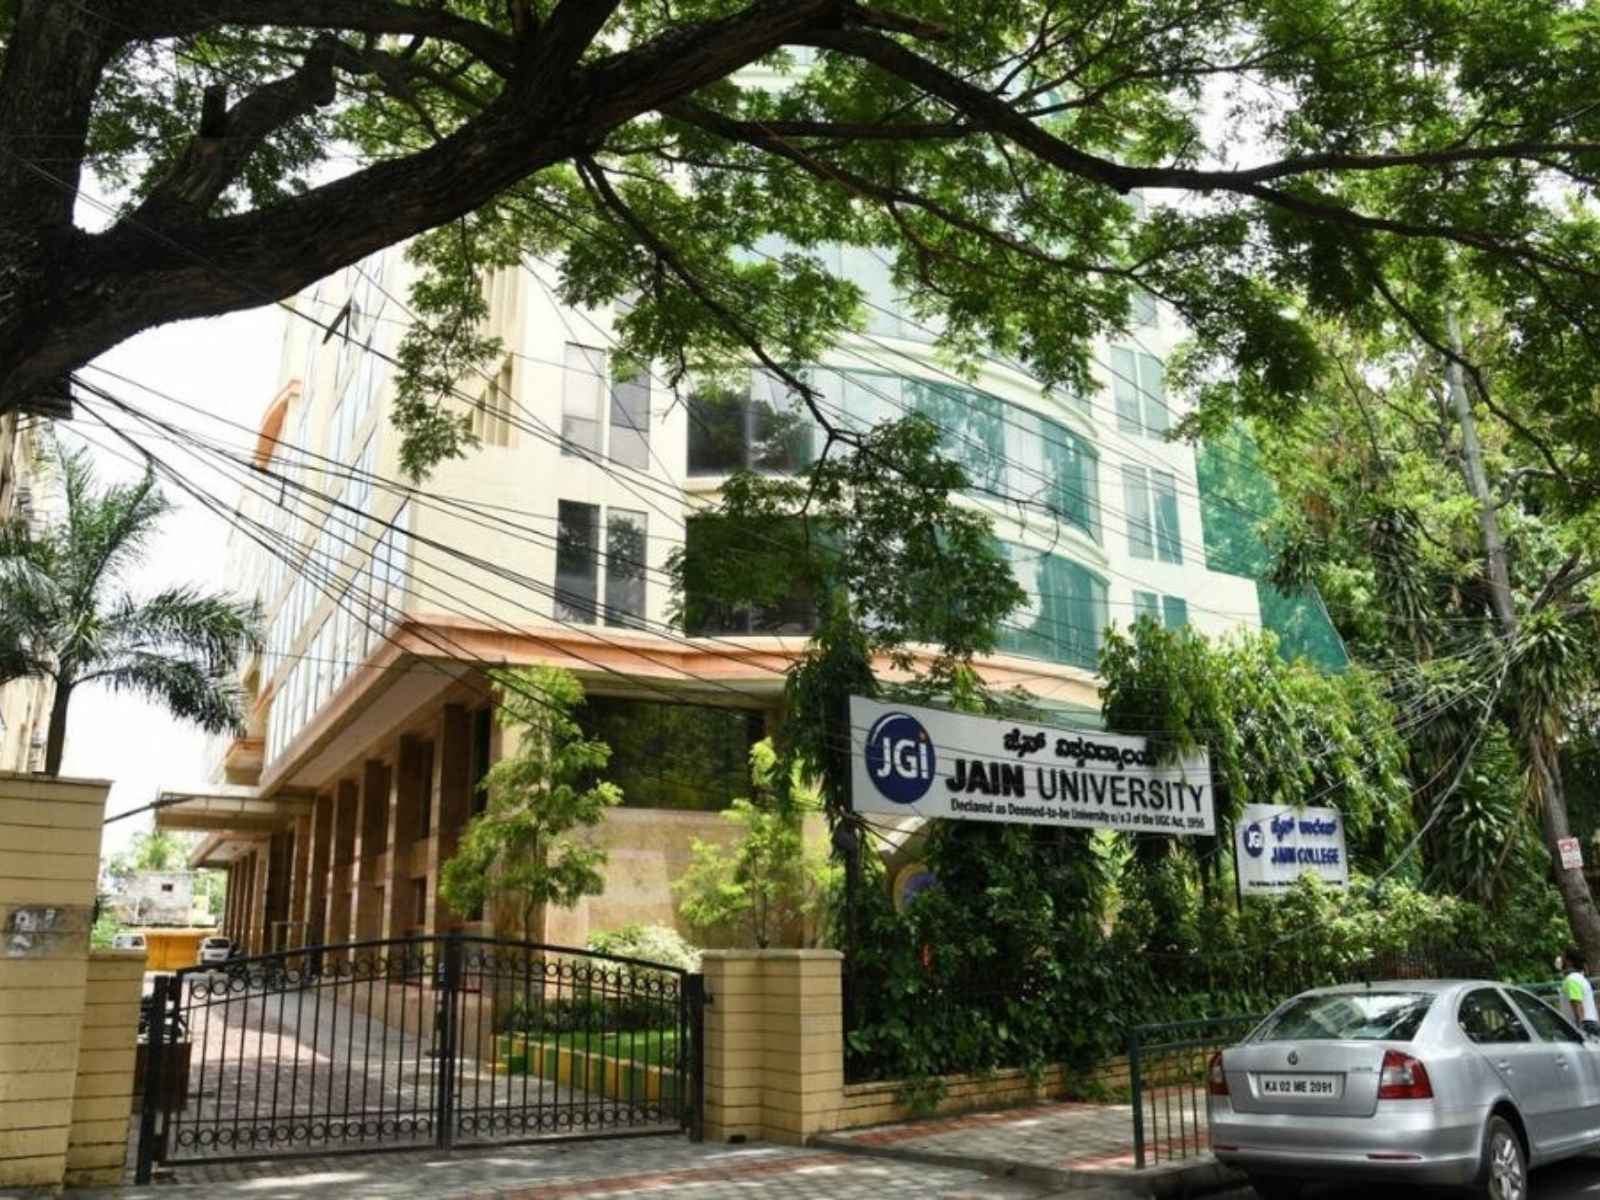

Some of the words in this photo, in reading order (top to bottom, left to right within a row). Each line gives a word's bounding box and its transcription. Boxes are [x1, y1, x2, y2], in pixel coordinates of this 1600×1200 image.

[945, 758, 1026, 798] JAIN
[1037, 767, 1203, 812] UNIVERSITY
[950, 798, 993, 813] Declared
[995, 804, 1007, 815] as
[1008, 803, 1070, 819] Deemed-to-be
[1071, 808, 1109, 824] University
[1133, 813, 1142, 824] of
[1142, 814, 1153, 825] the
[1154, 815, 1170, 826] UGC
[1270, 847, 1296, 865] JAIN
[1297, 847, 1340, 865] COLLEGE
[1264, 1080, 1277, 1092] KA
[1279, 1080, 1291, 1092] 02
